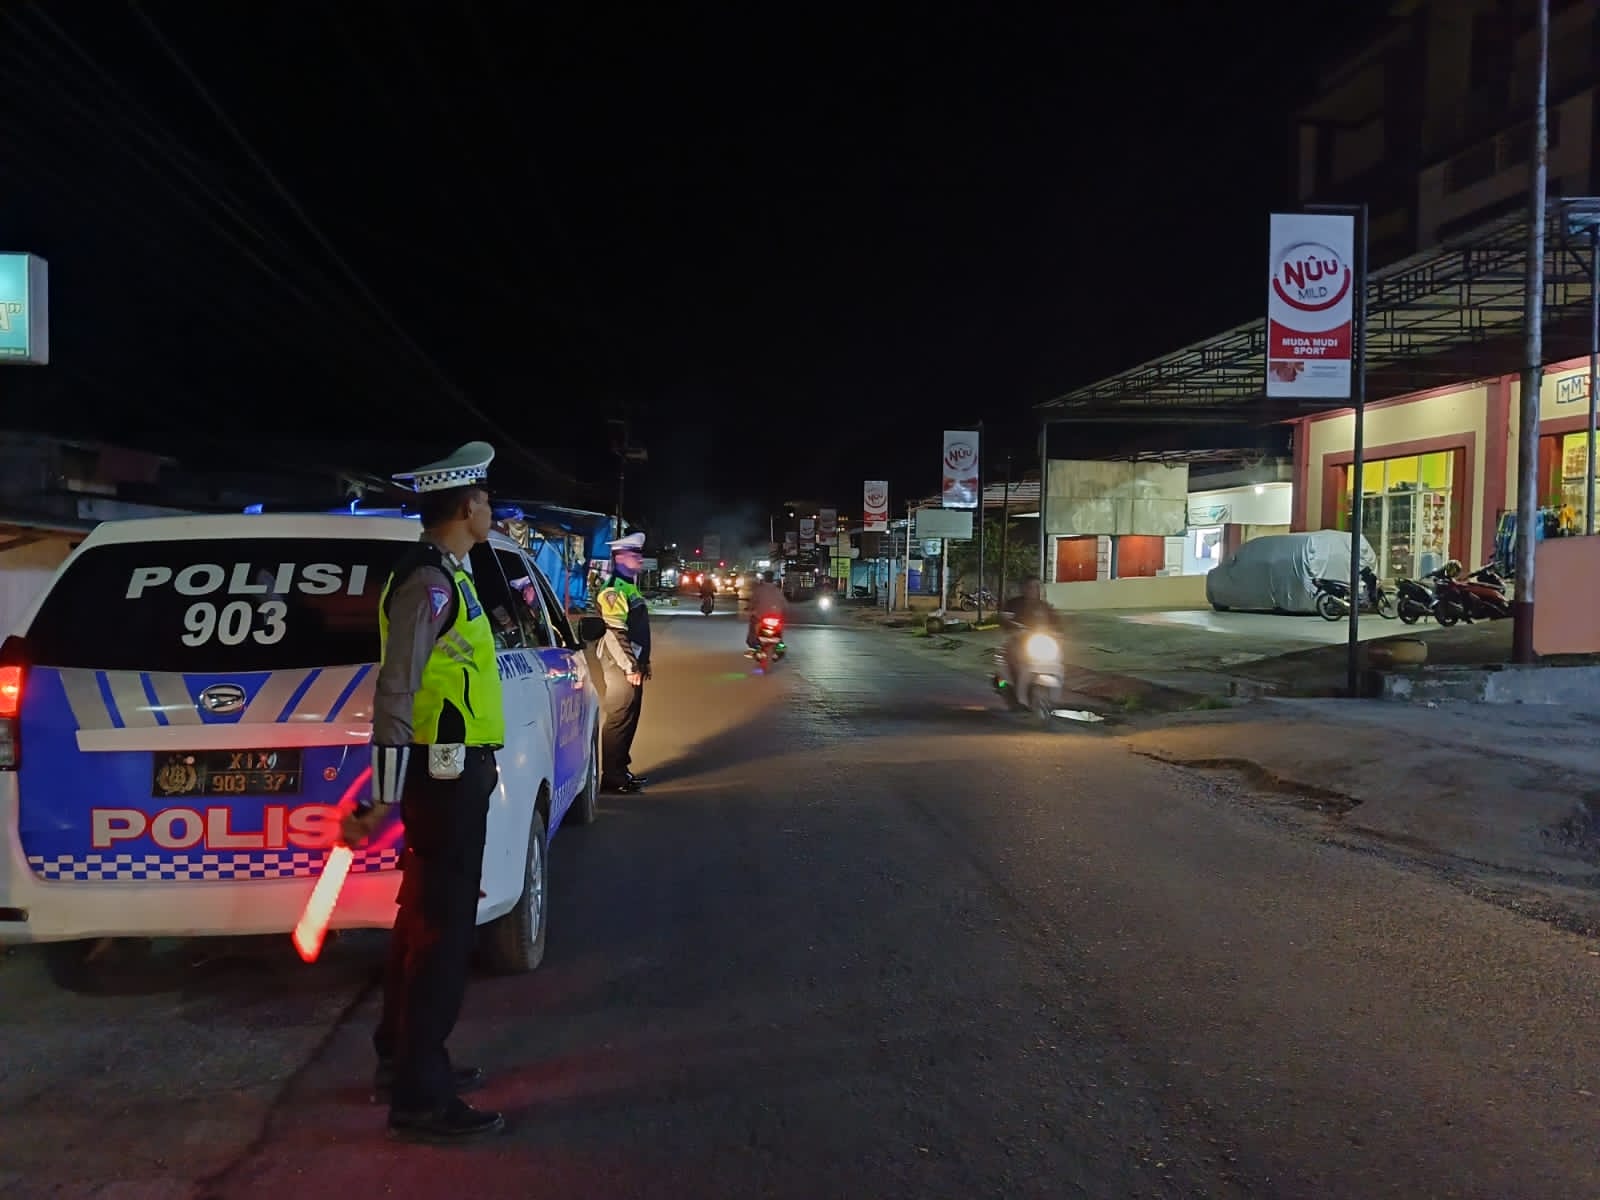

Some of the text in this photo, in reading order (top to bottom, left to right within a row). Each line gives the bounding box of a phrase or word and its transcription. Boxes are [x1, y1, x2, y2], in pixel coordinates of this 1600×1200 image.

[1298, 286, 1328, 300] MILD
[1281, 338, 1339, 347] MUDA MUDI
[1293, 346, 1326, 356] SPORT
[125, 562, 369, 599] POLISI
[181, 600, 288, 647] 903
[211, 774, 247, 792] 903
[90, 805, 367, 851] POLIS
